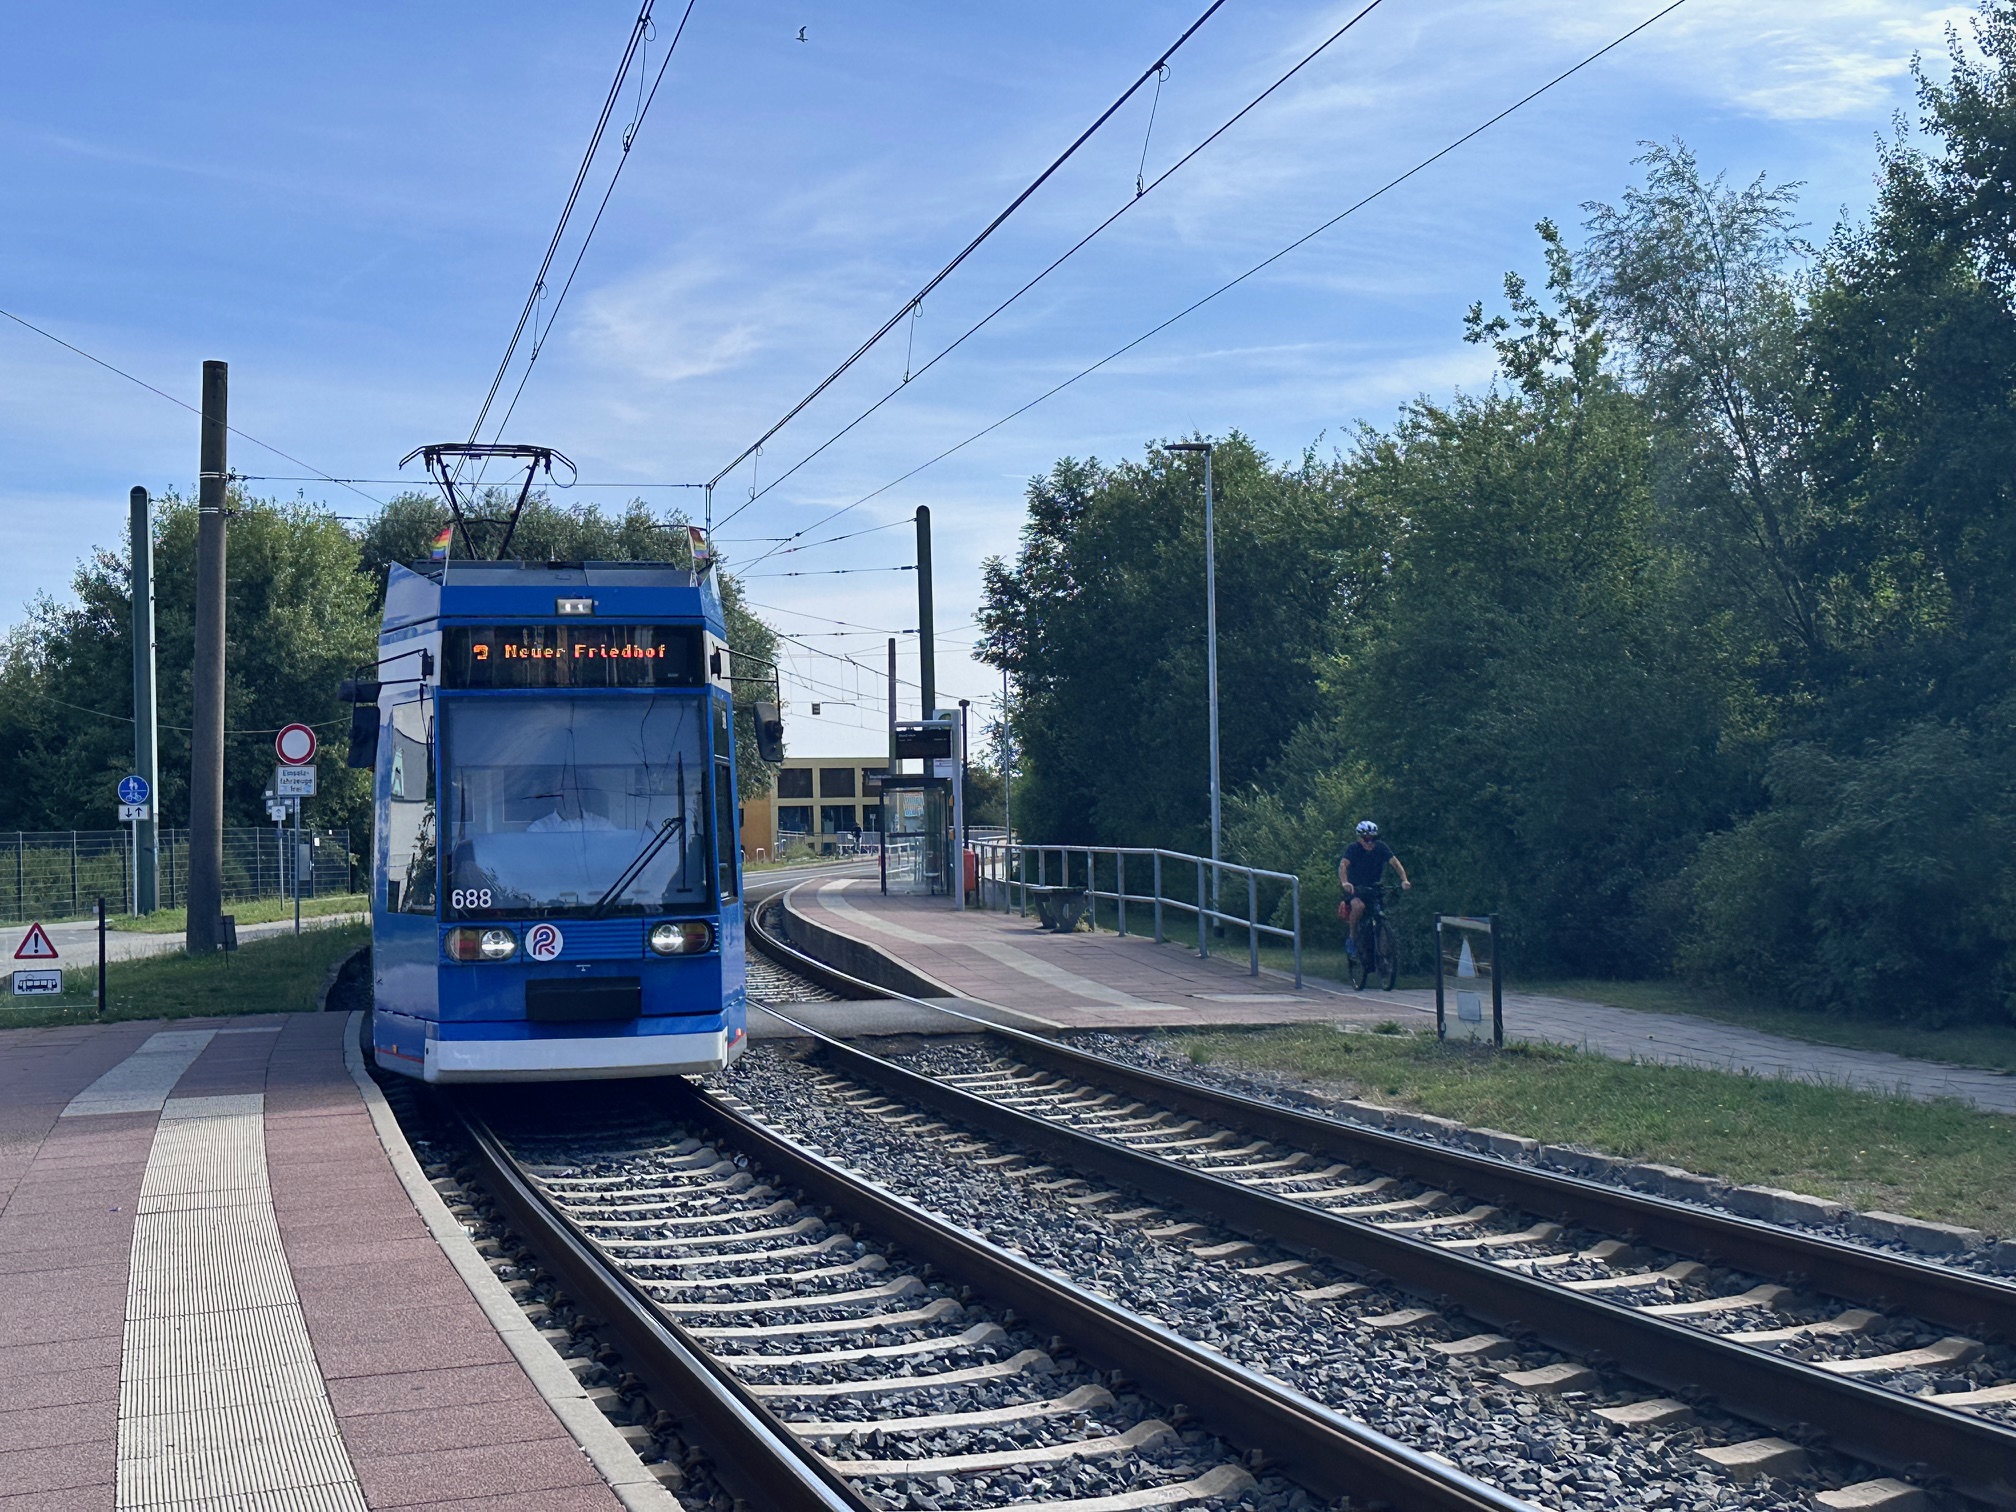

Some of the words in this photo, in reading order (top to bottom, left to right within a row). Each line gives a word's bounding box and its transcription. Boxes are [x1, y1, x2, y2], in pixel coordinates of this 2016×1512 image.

[504, 644, 566, 658] Neuer
[574, 644, 666, 658] Friedhof
[451, 888, 492, 910] 688
